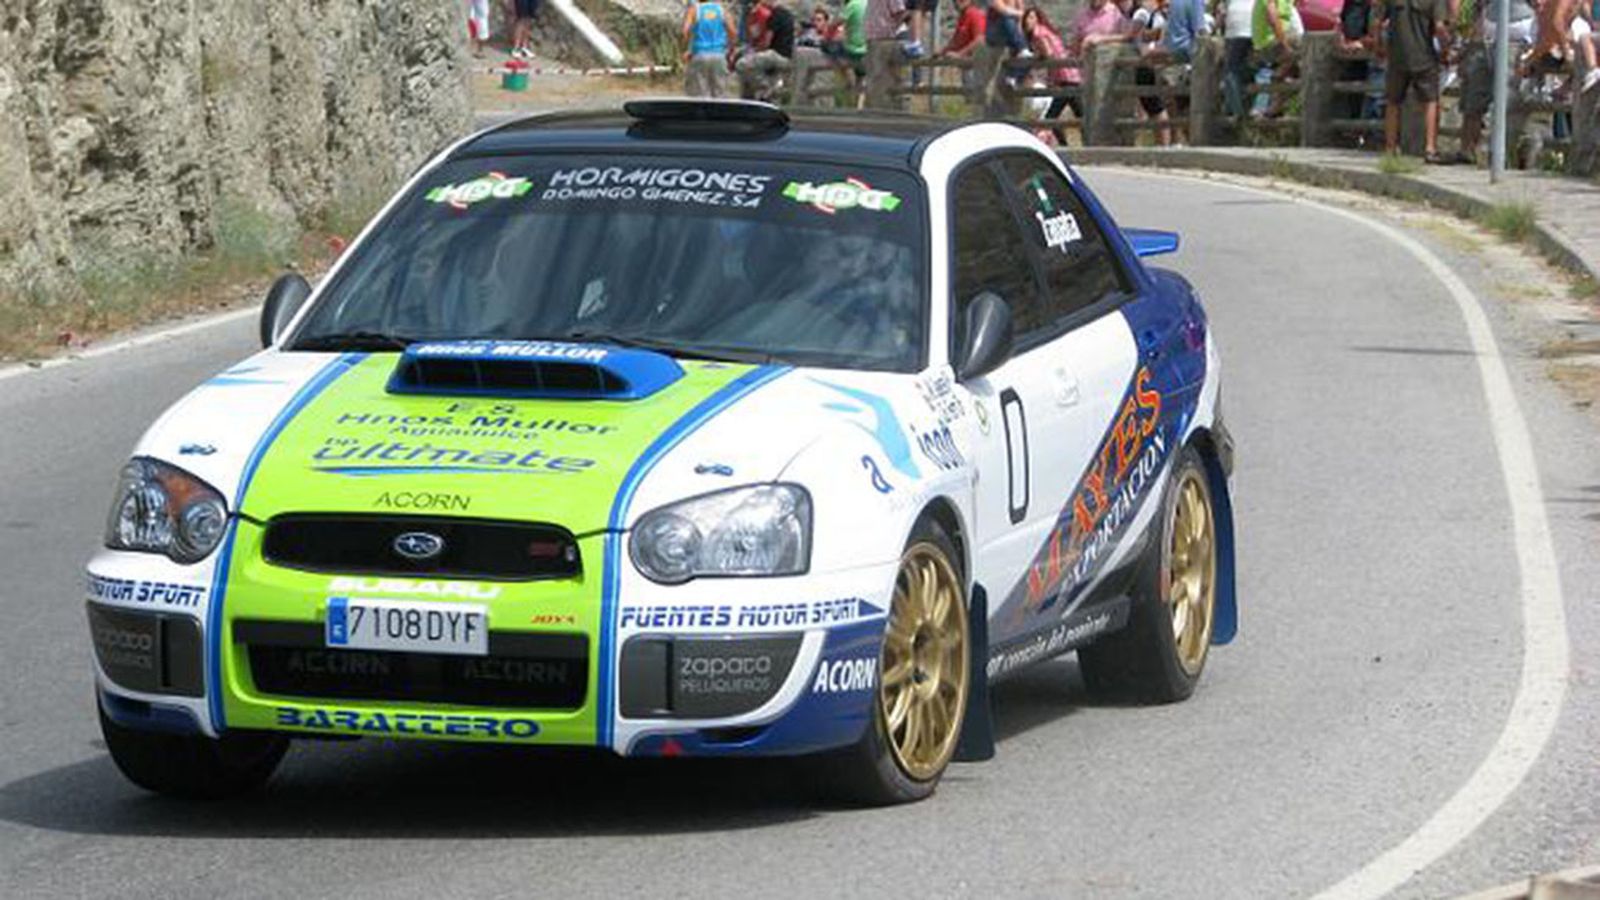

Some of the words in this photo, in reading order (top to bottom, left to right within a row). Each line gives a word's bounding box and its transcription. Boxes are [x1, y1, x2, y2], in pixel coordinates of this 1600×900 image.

[542, 186, 637, 201] DOMINGO
[549, 166, 772, 195] HORMIGONES
[336, 412, 453, 425] Hnos
[469, 415, 618, 435] Mullor
[312, 442, 597, 473] ultimate
[999, 385, 1031, 526] 0
[373, 491, 472, 511] ACORN
[136, 581, 206, 606] SPORT
[328, 577, 504, 598] SUBARU
[620, 605, 734, 628] FUENTES
[737, 603, 808, 627] MOTOR
[811, 596, 859, 623] SPORT
[463, 659, 569, 685] ACORN
[813, 657, 876, 693] ACORN
